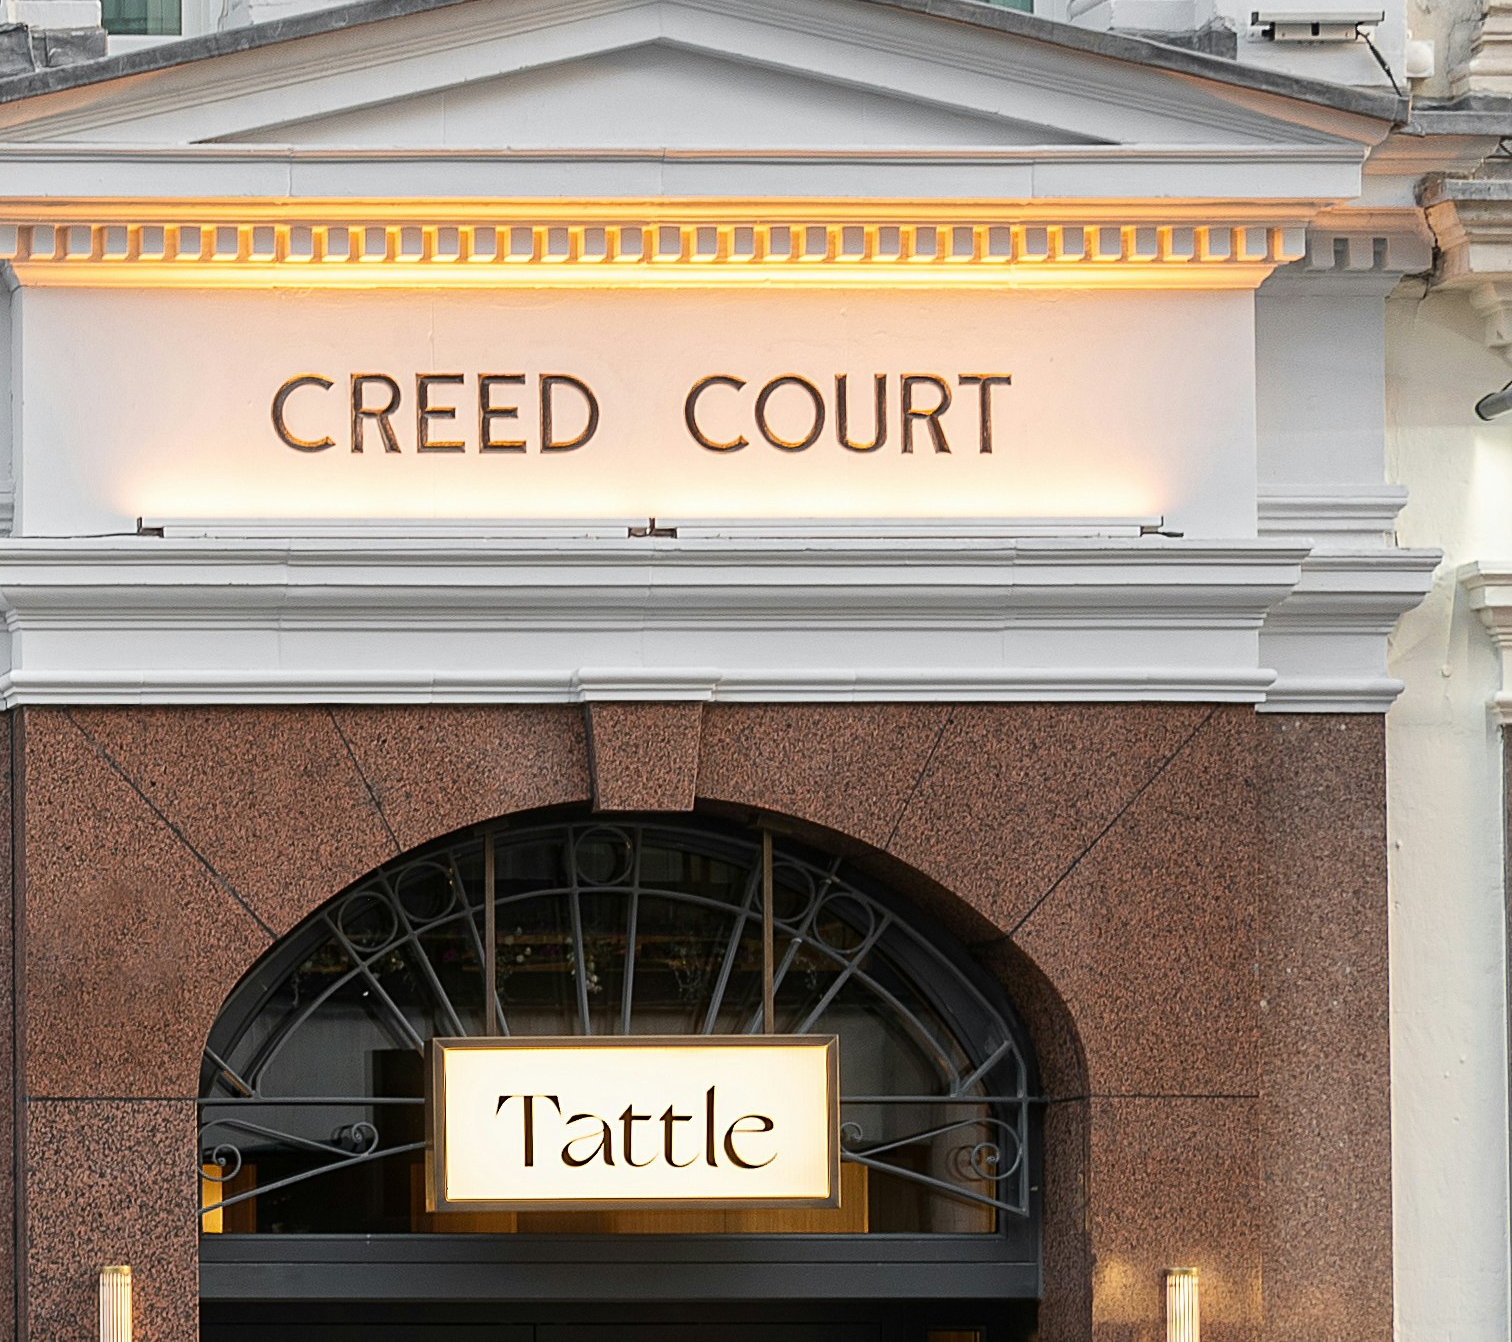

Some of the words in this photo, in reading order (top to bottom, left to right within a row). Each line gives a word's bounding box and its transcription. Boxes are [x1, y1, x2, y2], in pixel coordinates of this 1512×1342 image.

[270, 372, 600, 454] CREED
[684, 372, 1012, 454] COURT
[495, 1085, 778, 1170] Tattle
